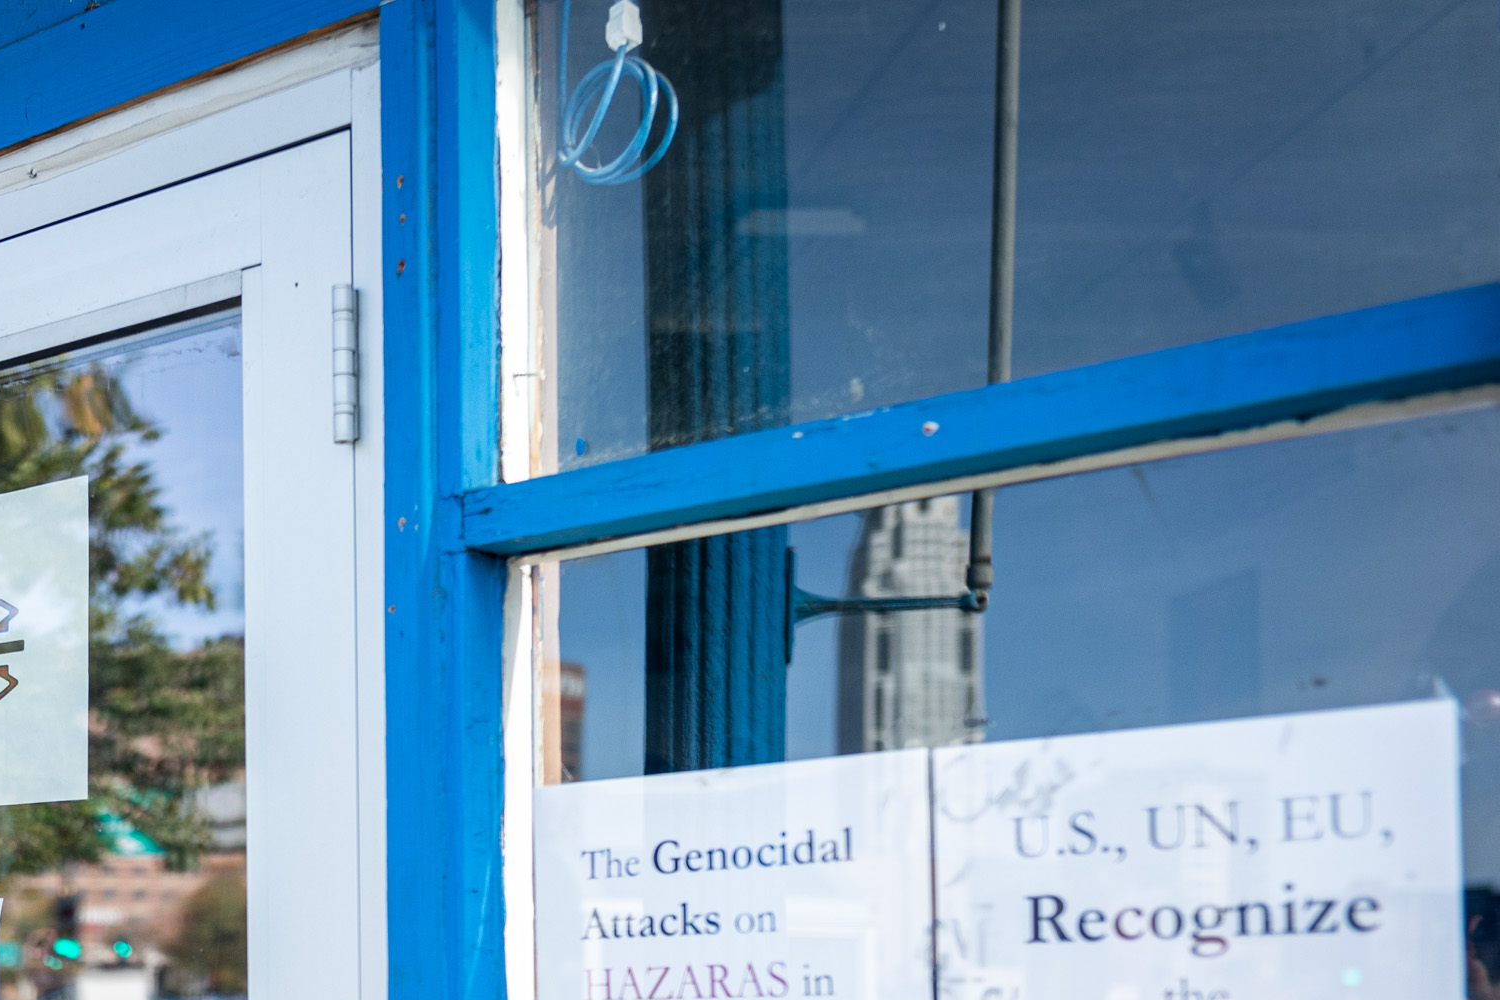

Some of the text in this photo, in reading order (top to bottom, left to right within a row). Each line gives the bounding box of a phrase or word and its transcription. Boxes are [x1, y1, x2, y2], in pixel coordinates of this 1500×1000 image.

[581, 827, 855, 880] The Genocidal
[1011, 791, 1394, 863] U.S., UN, EU,
[581, 903, 778, 940] Attacks on
[1025, 882, 1383, 958] Recognize
[802, 964, 835, 998] in
